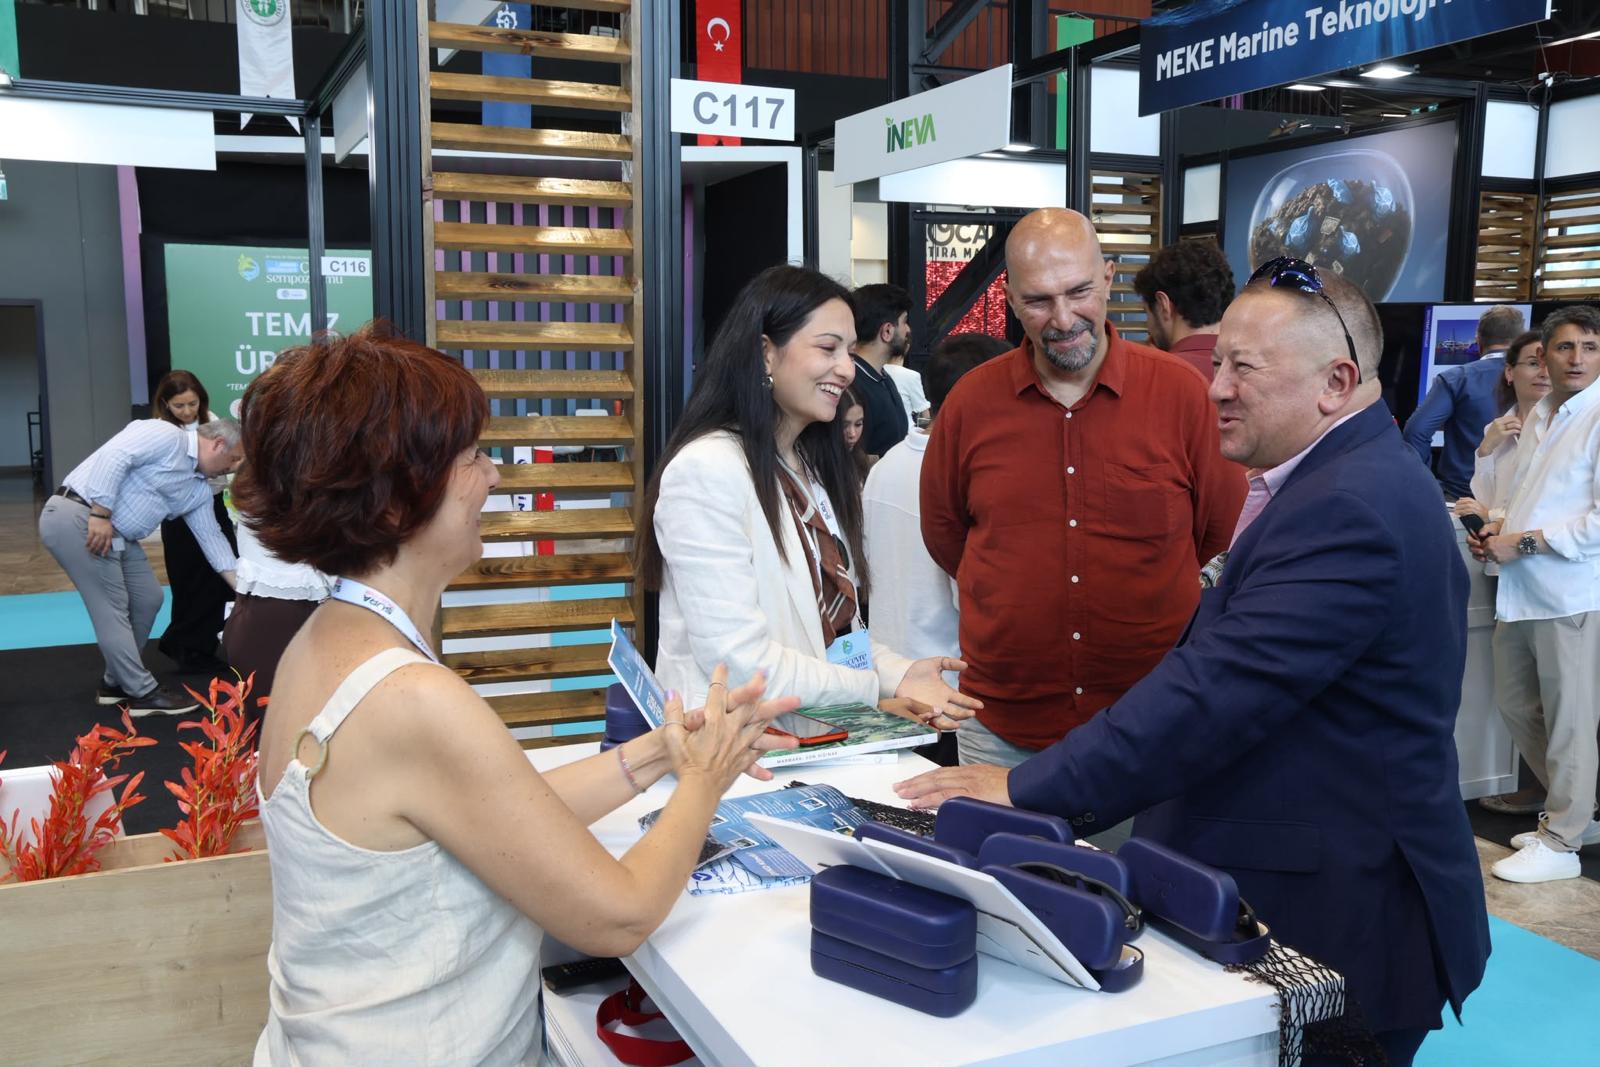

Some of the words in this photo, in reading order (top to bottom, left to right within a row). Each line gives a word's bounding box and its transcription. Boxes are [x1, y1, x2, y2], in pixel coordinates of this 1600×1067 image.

[1156, 38, 1215, 82] MEKE
[1219, 21, 1300, 65] Marine
[1305, 0, 1437, 41] Teknoloj
[693, 91, 785, 129] C117
[928, 246, 957, 259] TIRA
[329, 260, 367, 274] C116
[266, 272, 343, 286] sempozmu
[245, 311, 340, 337] TEMZ
